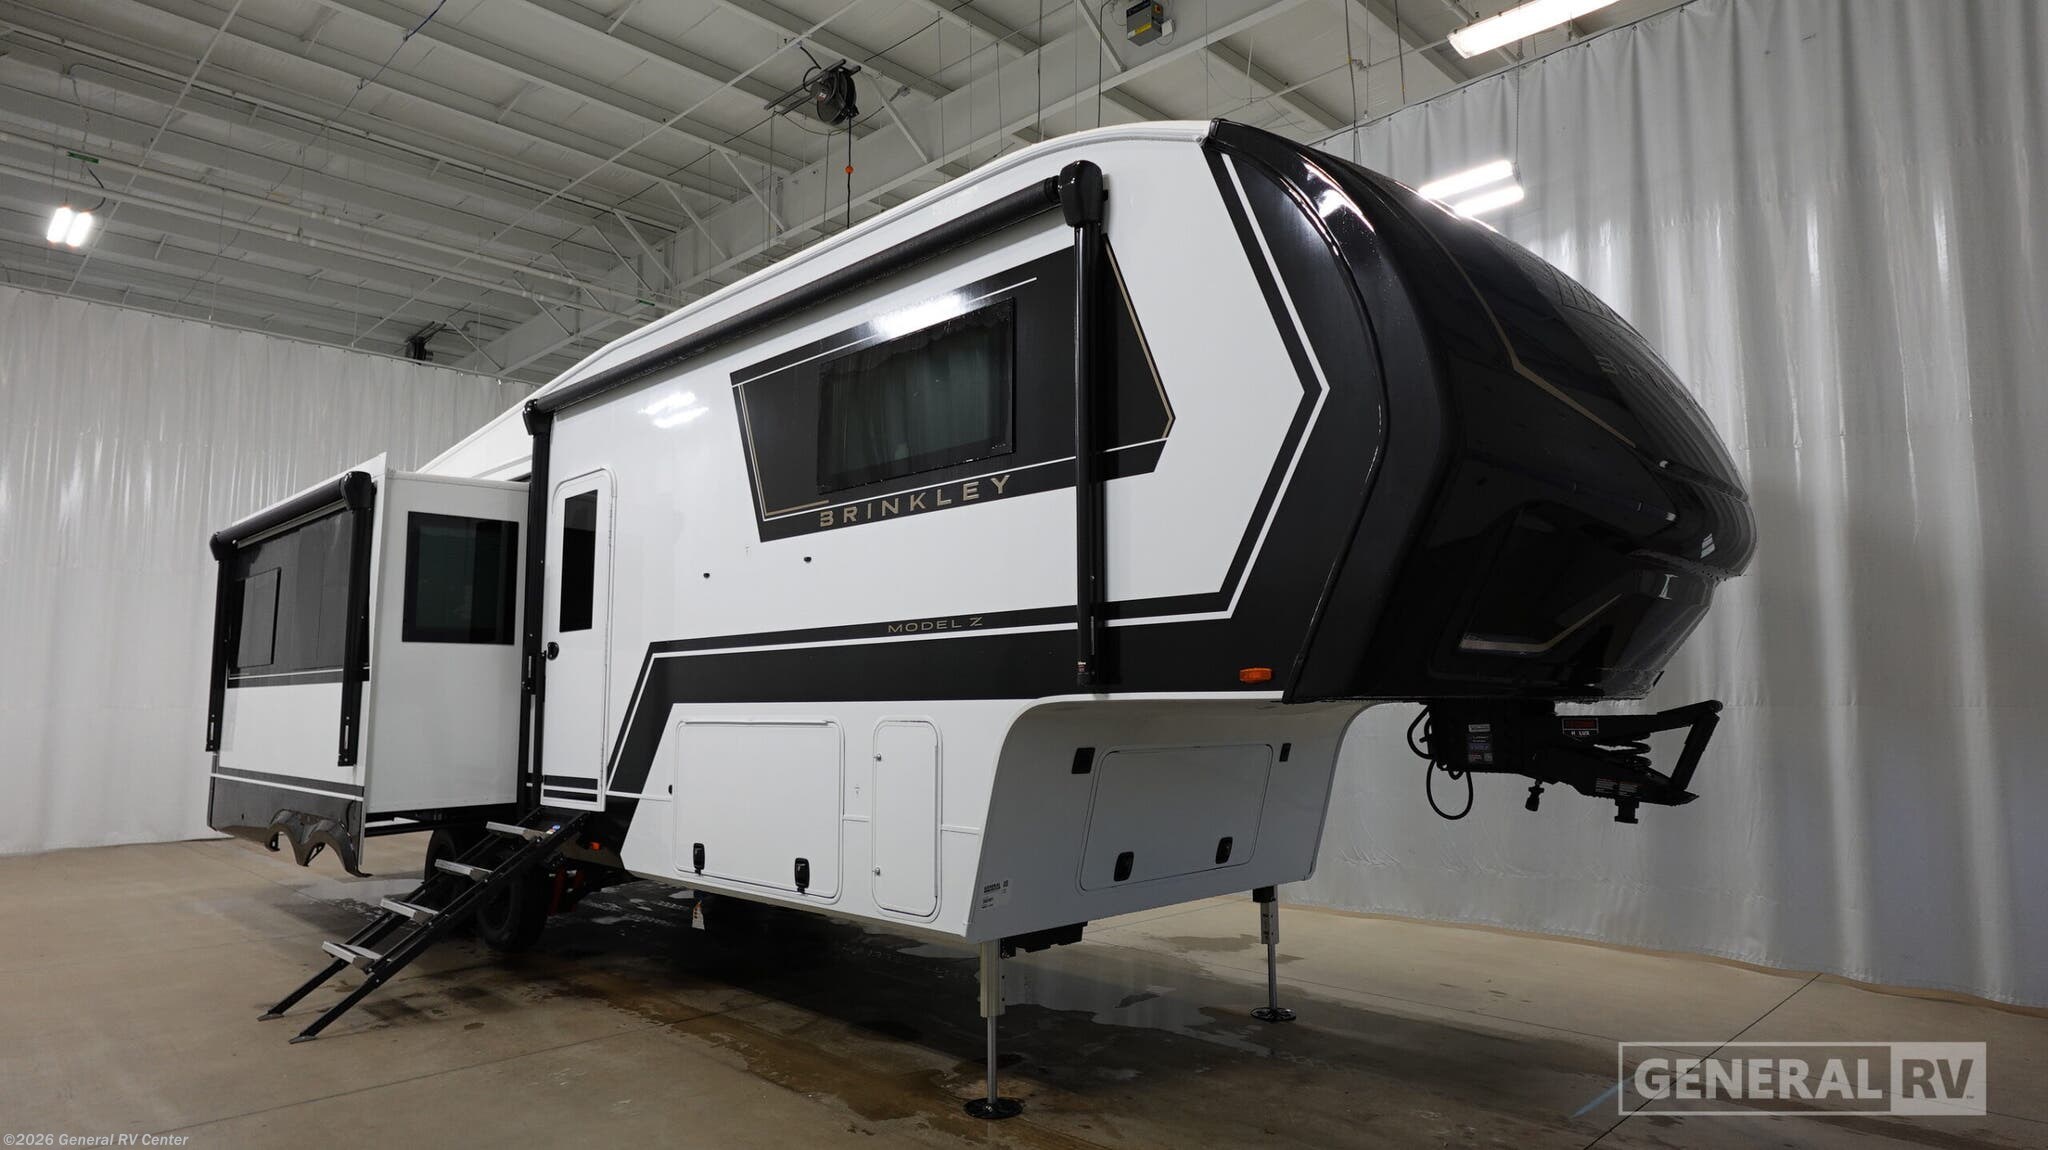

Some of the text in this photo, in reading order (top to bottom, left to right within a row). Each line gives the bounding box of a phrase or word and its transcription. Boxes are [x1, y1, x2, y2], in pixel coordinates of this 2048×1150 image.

[820, 474, 1010, 528] BRINKLEY
[888, 616, 983, 633] MODEL Z
